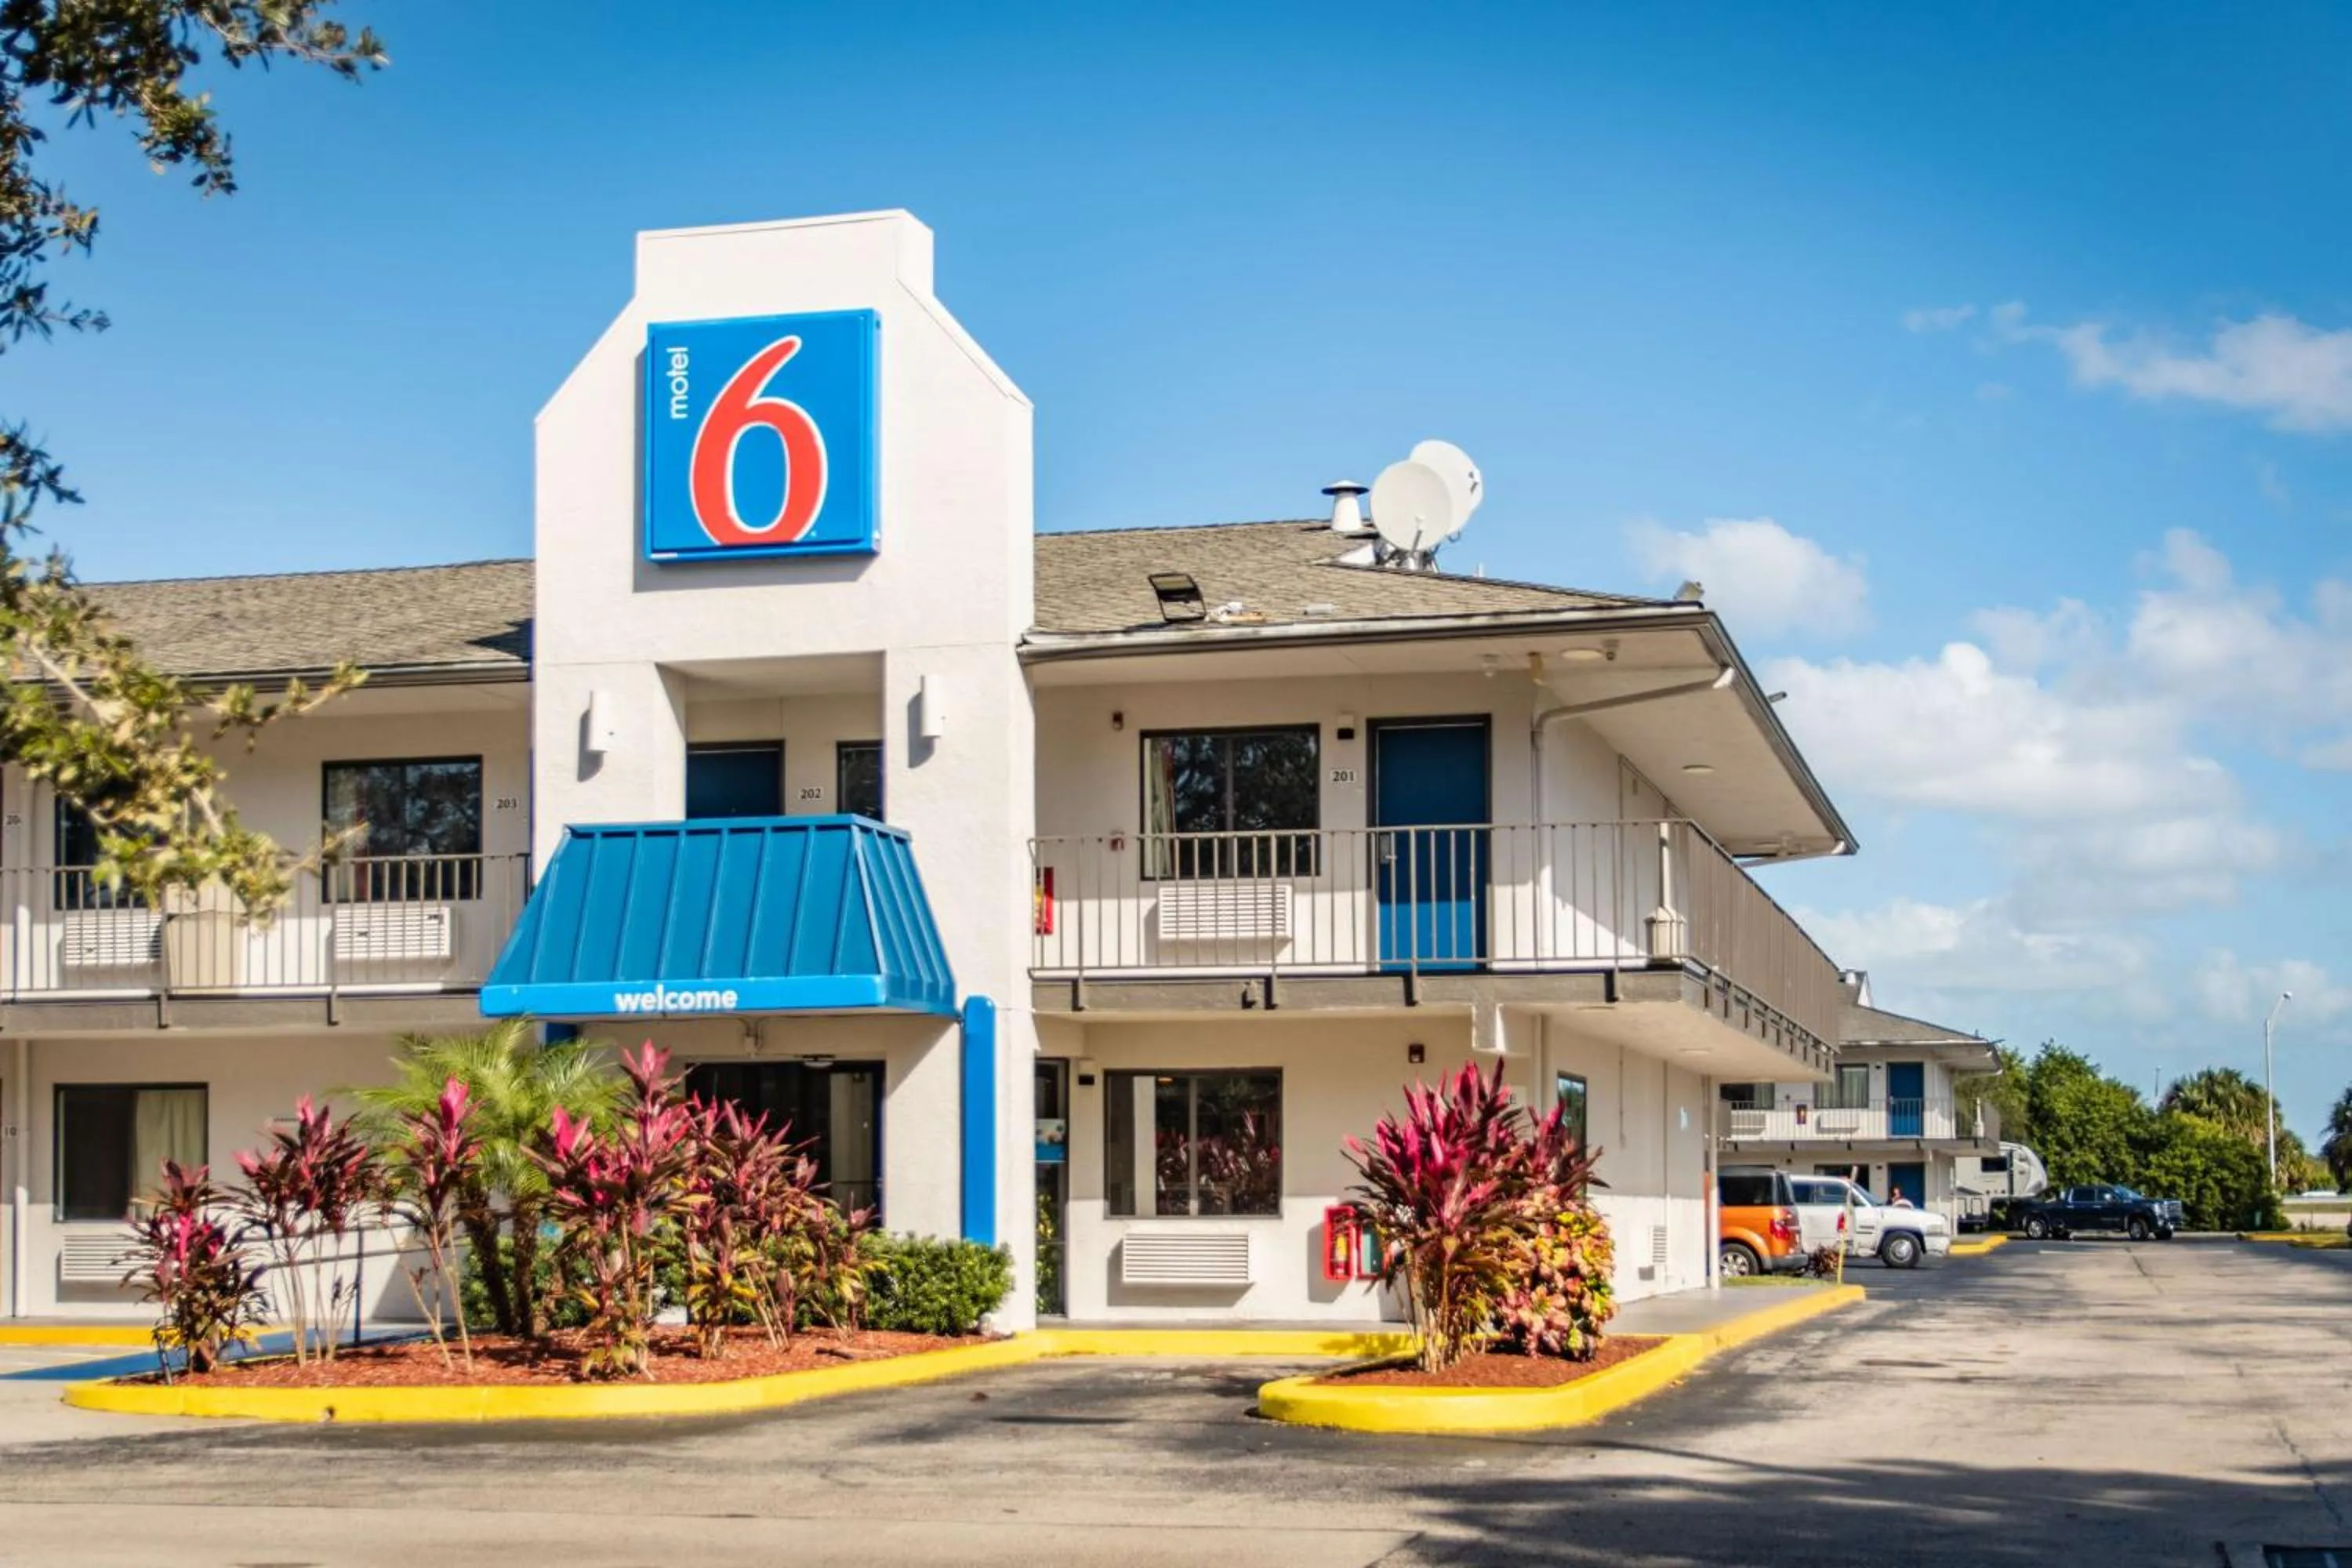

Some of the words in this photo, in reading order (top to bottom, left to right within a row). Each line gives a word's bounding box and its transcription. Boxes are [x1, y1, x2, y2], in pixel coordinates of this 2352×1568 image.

[666, 347, 689, 419] motel
[689, 335, 828, 546] 6
[1332, 771, 1355, 782] 201
[800, 788, 822, 799] 202
[615, 984, 738, 1012] welcome
